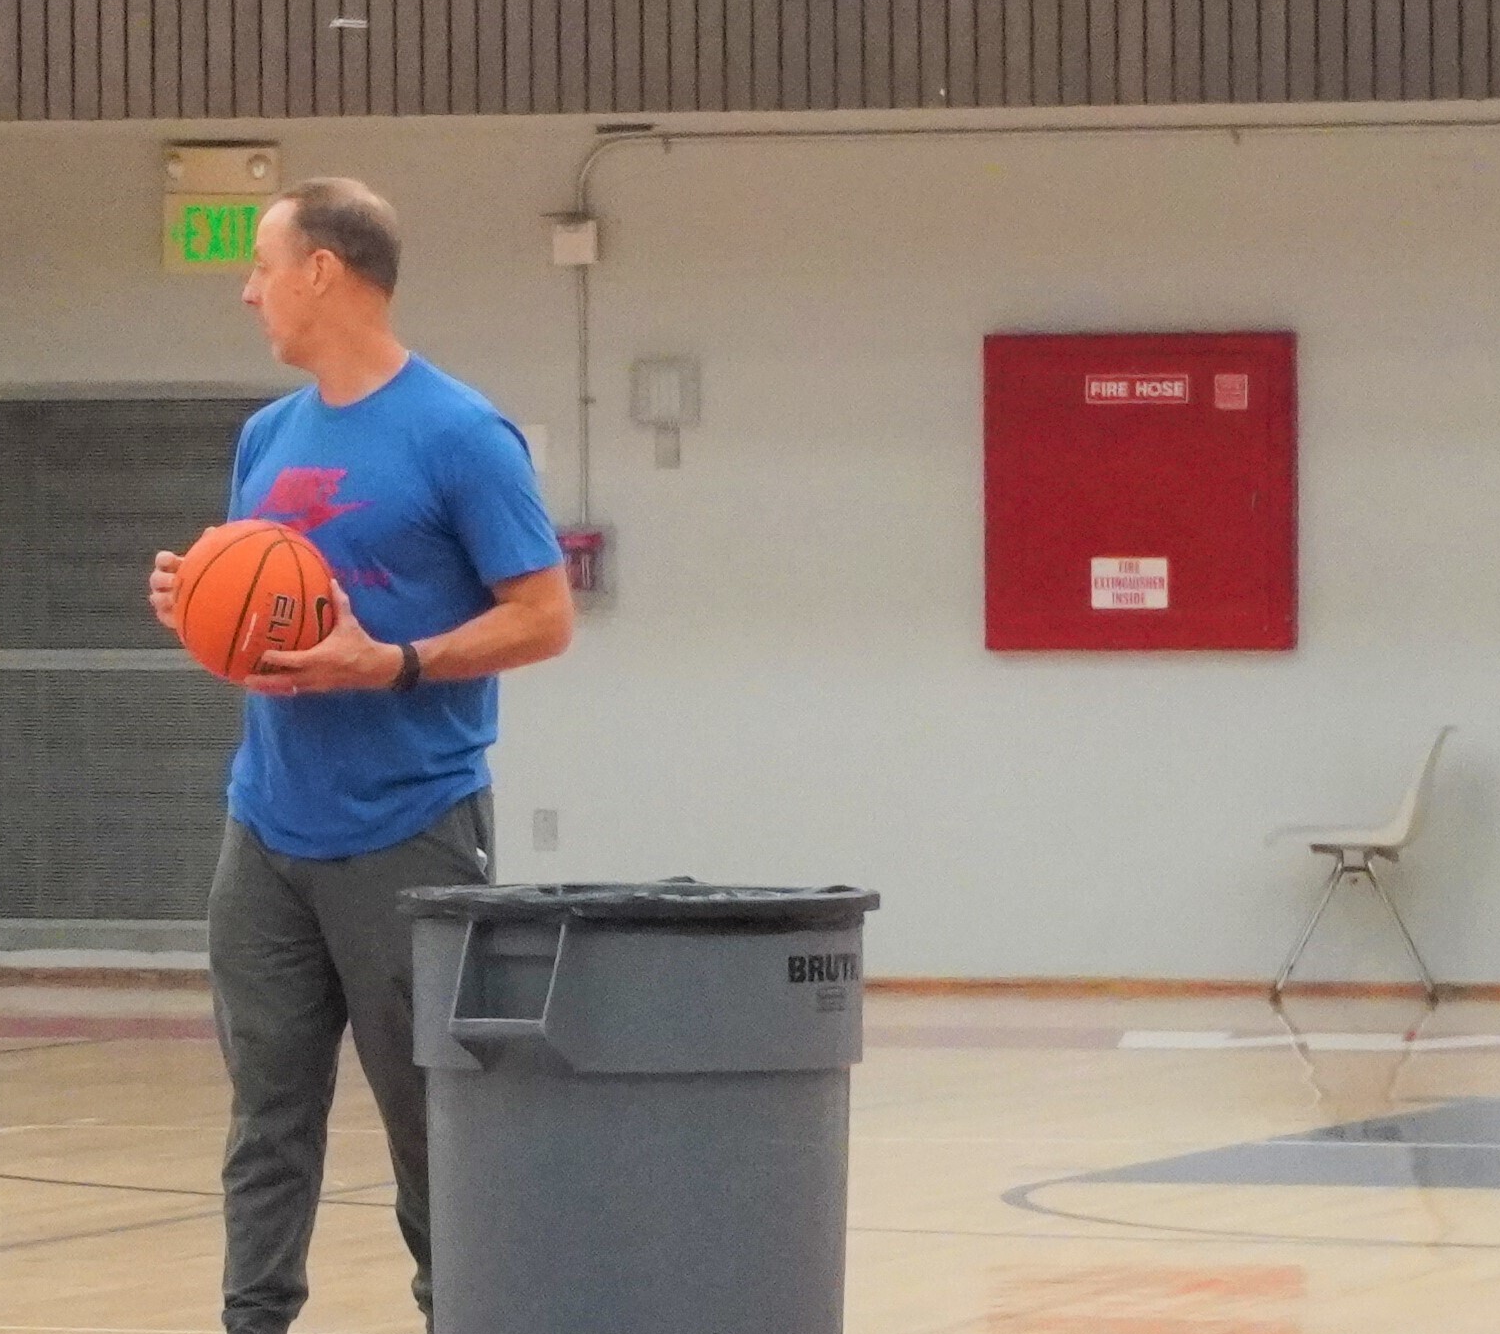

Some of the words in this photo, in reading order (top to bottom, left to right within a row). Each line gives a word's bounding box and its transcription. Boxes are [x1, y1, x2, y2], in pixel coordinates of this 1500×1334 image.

[184, 205, 258, 261] EXIT
[1090, 380, 1128, 397] FIRE
[1136, 380, 1186, 397] HOSE
[1118, 561, 1141, 574] FIRE
[1093, 576, 1165, 590] EXTINGUISHER
[1111, 591, 1146, 605] INSIDE
